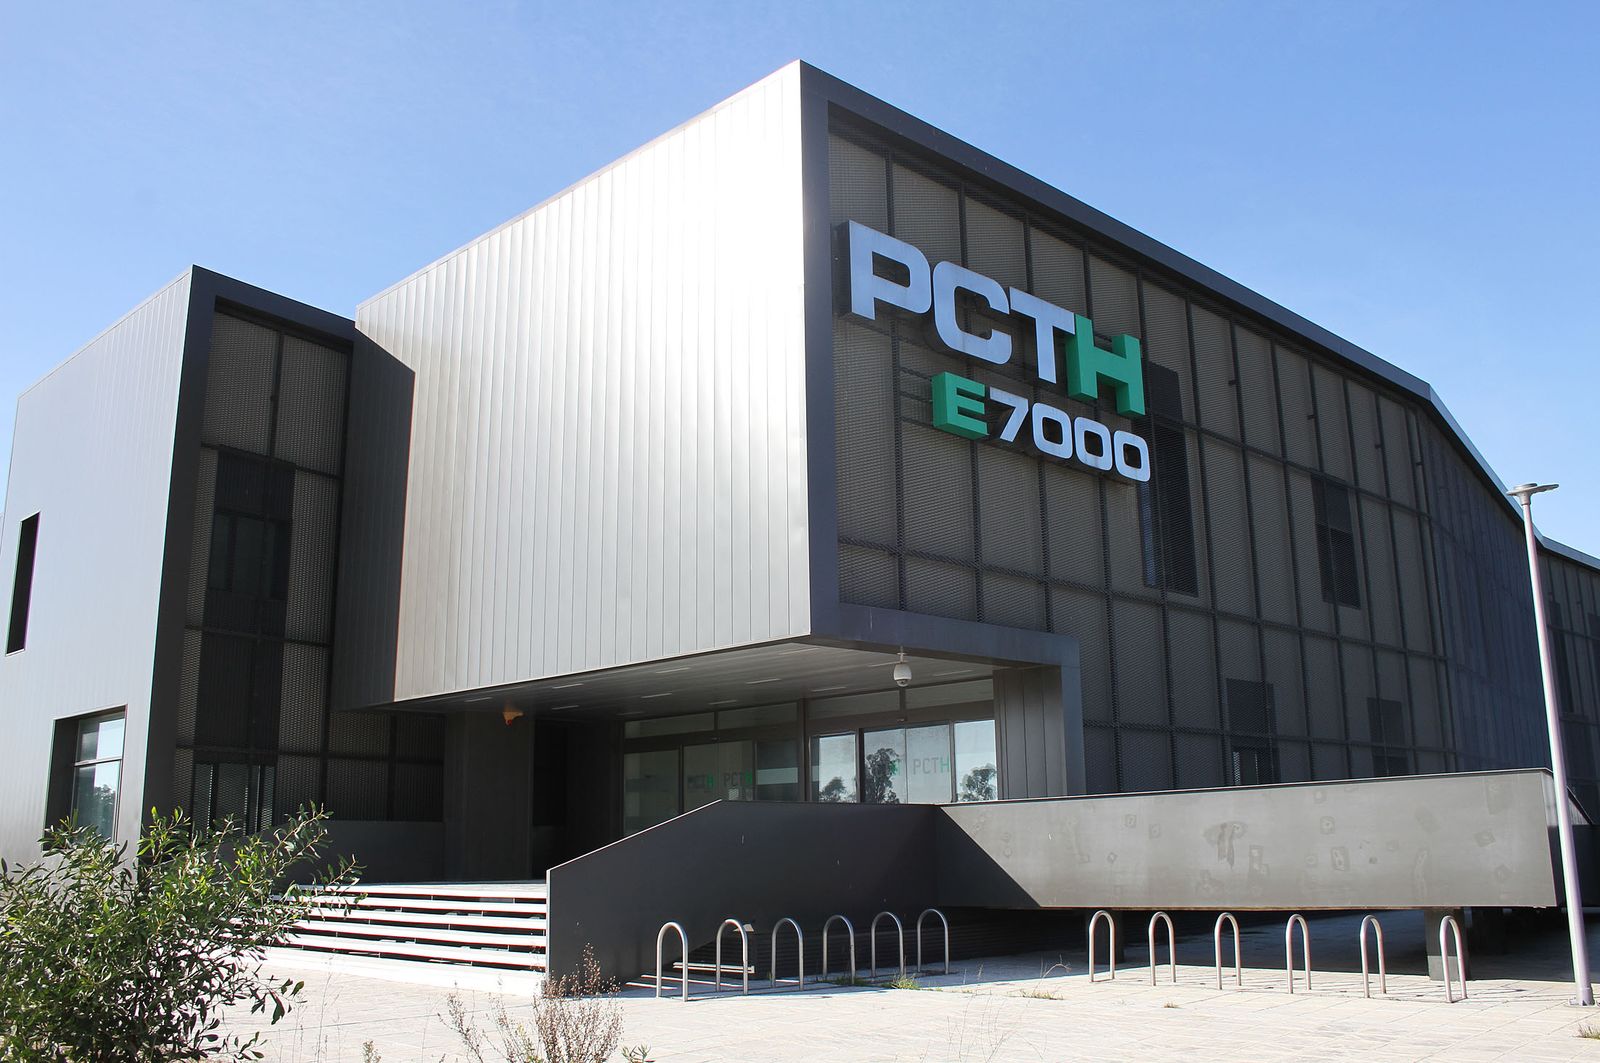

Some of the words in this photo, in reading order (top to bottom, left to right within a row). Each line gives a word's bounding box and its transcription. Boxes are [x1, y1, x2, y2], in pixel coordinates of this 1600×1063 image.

[848, 220, 1146, 417] PCTH
[932, 371, 1151, 482] E7000
[912, 755, 950, 775] PCTH
